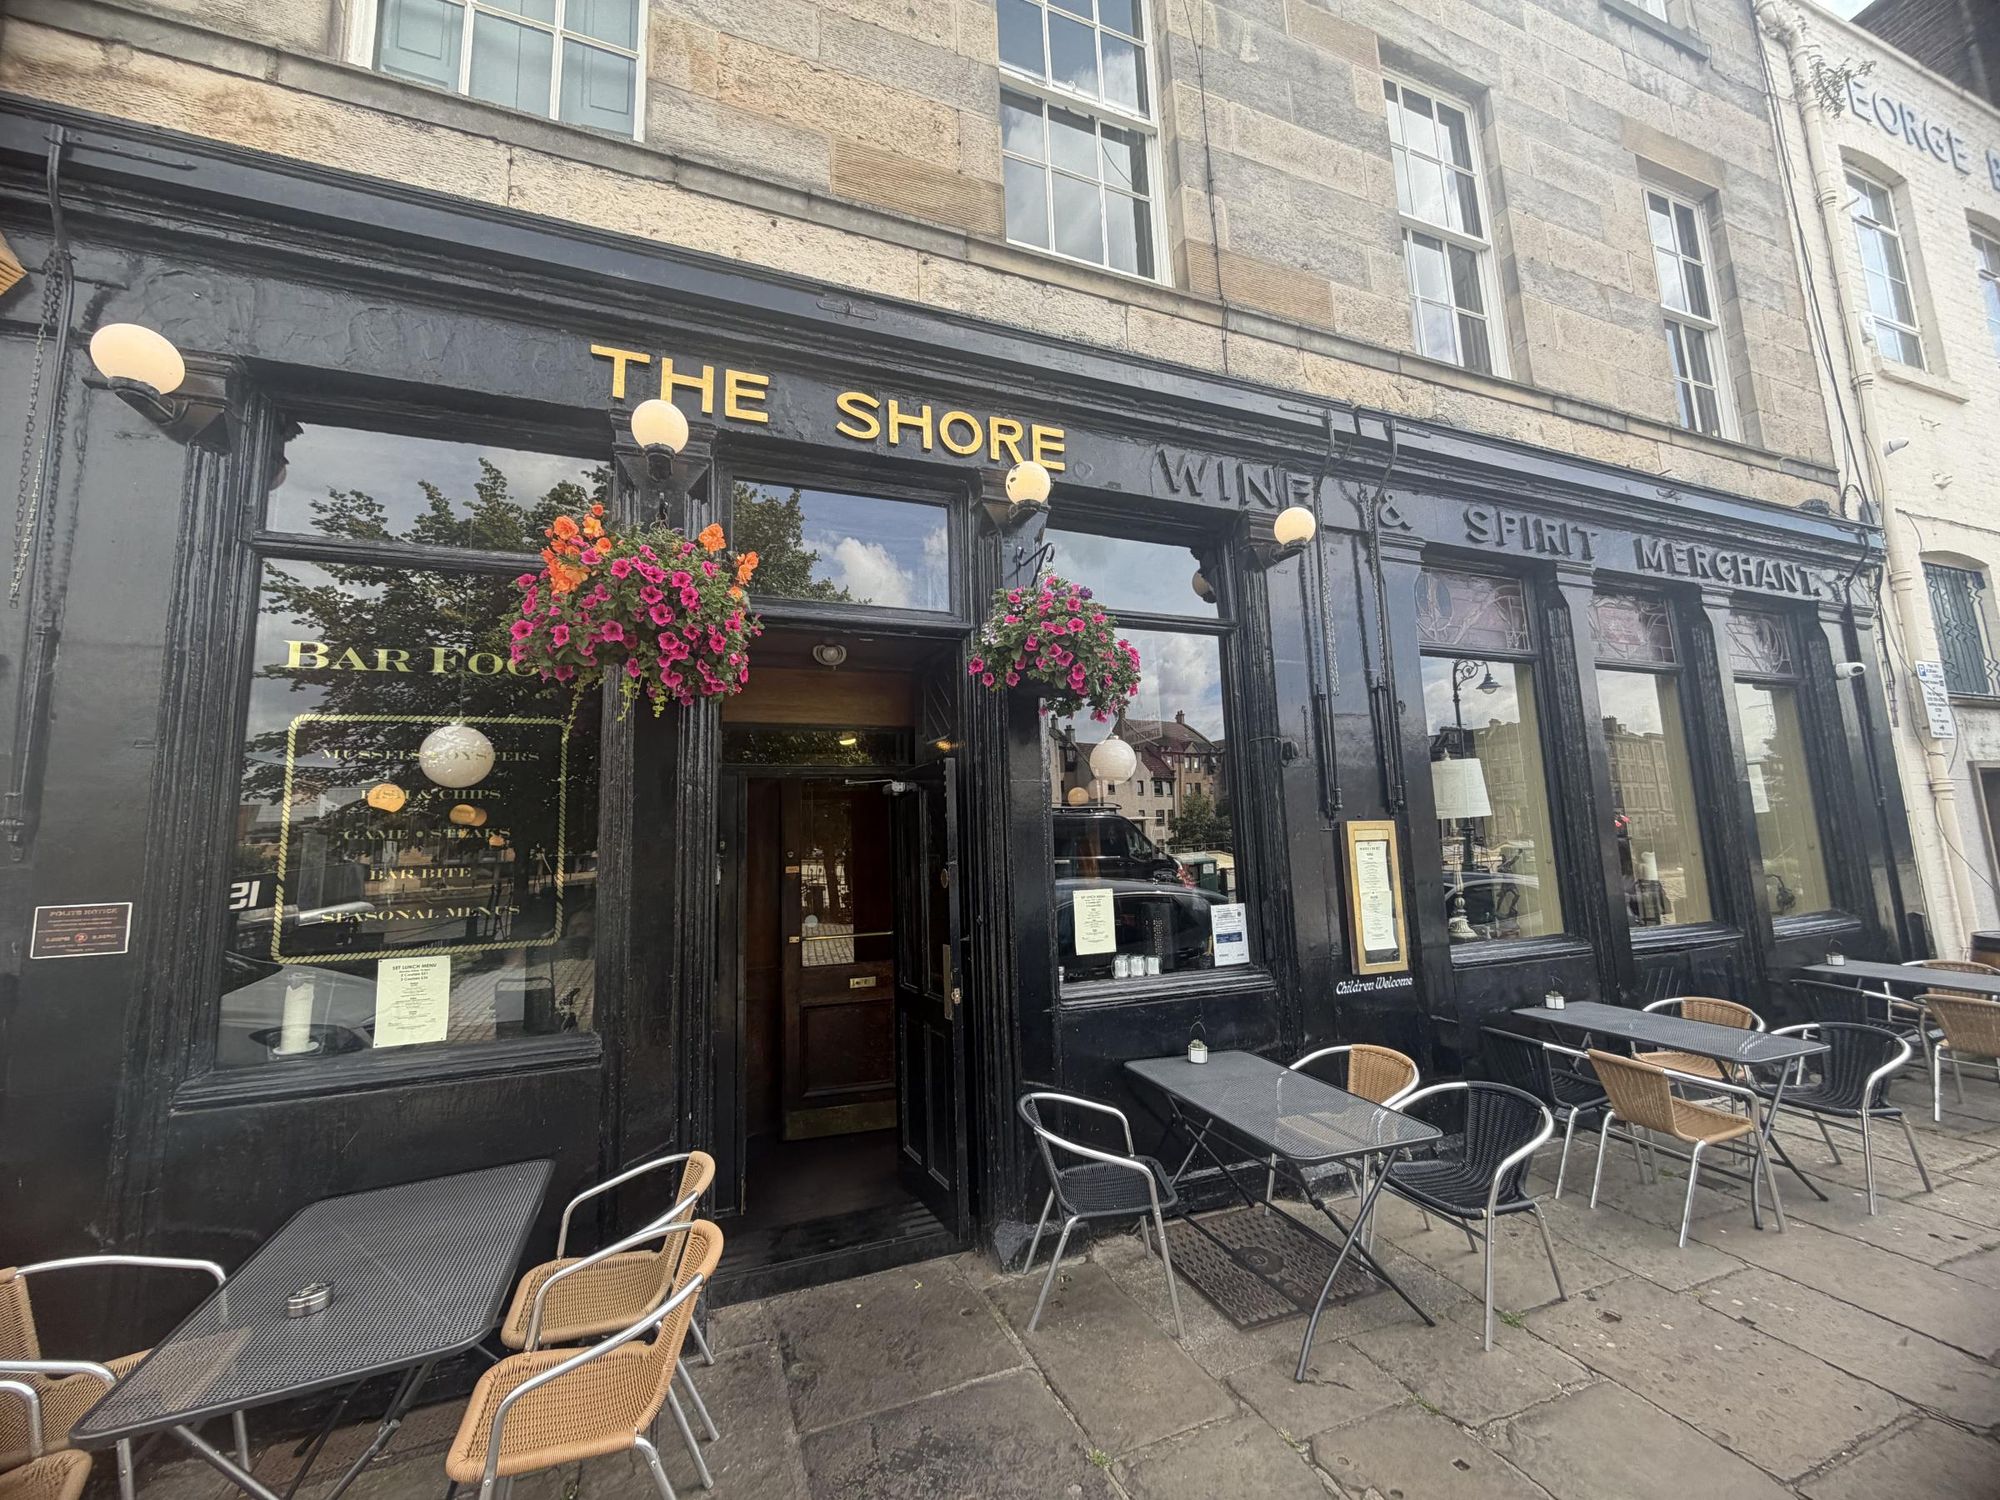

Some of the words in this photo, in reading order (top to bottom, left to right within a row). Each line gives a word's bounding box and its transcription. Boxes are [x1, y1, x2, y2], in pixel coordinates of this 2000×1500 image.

[1846, 70, 1971, 175] EORGE
[590, 344, 769, 423] THE
[836, 392, 1066, 471] SHORE
[1154, 450, 1314, 508] WINE
[1378, 490, 1414, 531] &
[1463, 505, 1599, 560] SPIRIT
[439, 789, 501, 800] CHIPS
[343, 829, 408, 840] GAME
[431, 828, 511, 839] STEAKS
[369, 869, 414, 881] BAR
[421, 868, 472, 880] BITE
[321, 908, 439, 923] SEASONAL
[446, 905, 520, 918] MENUS
[1335, 979, 1374, 995] Children
[1375, 976, 1413, 989] Welcome
